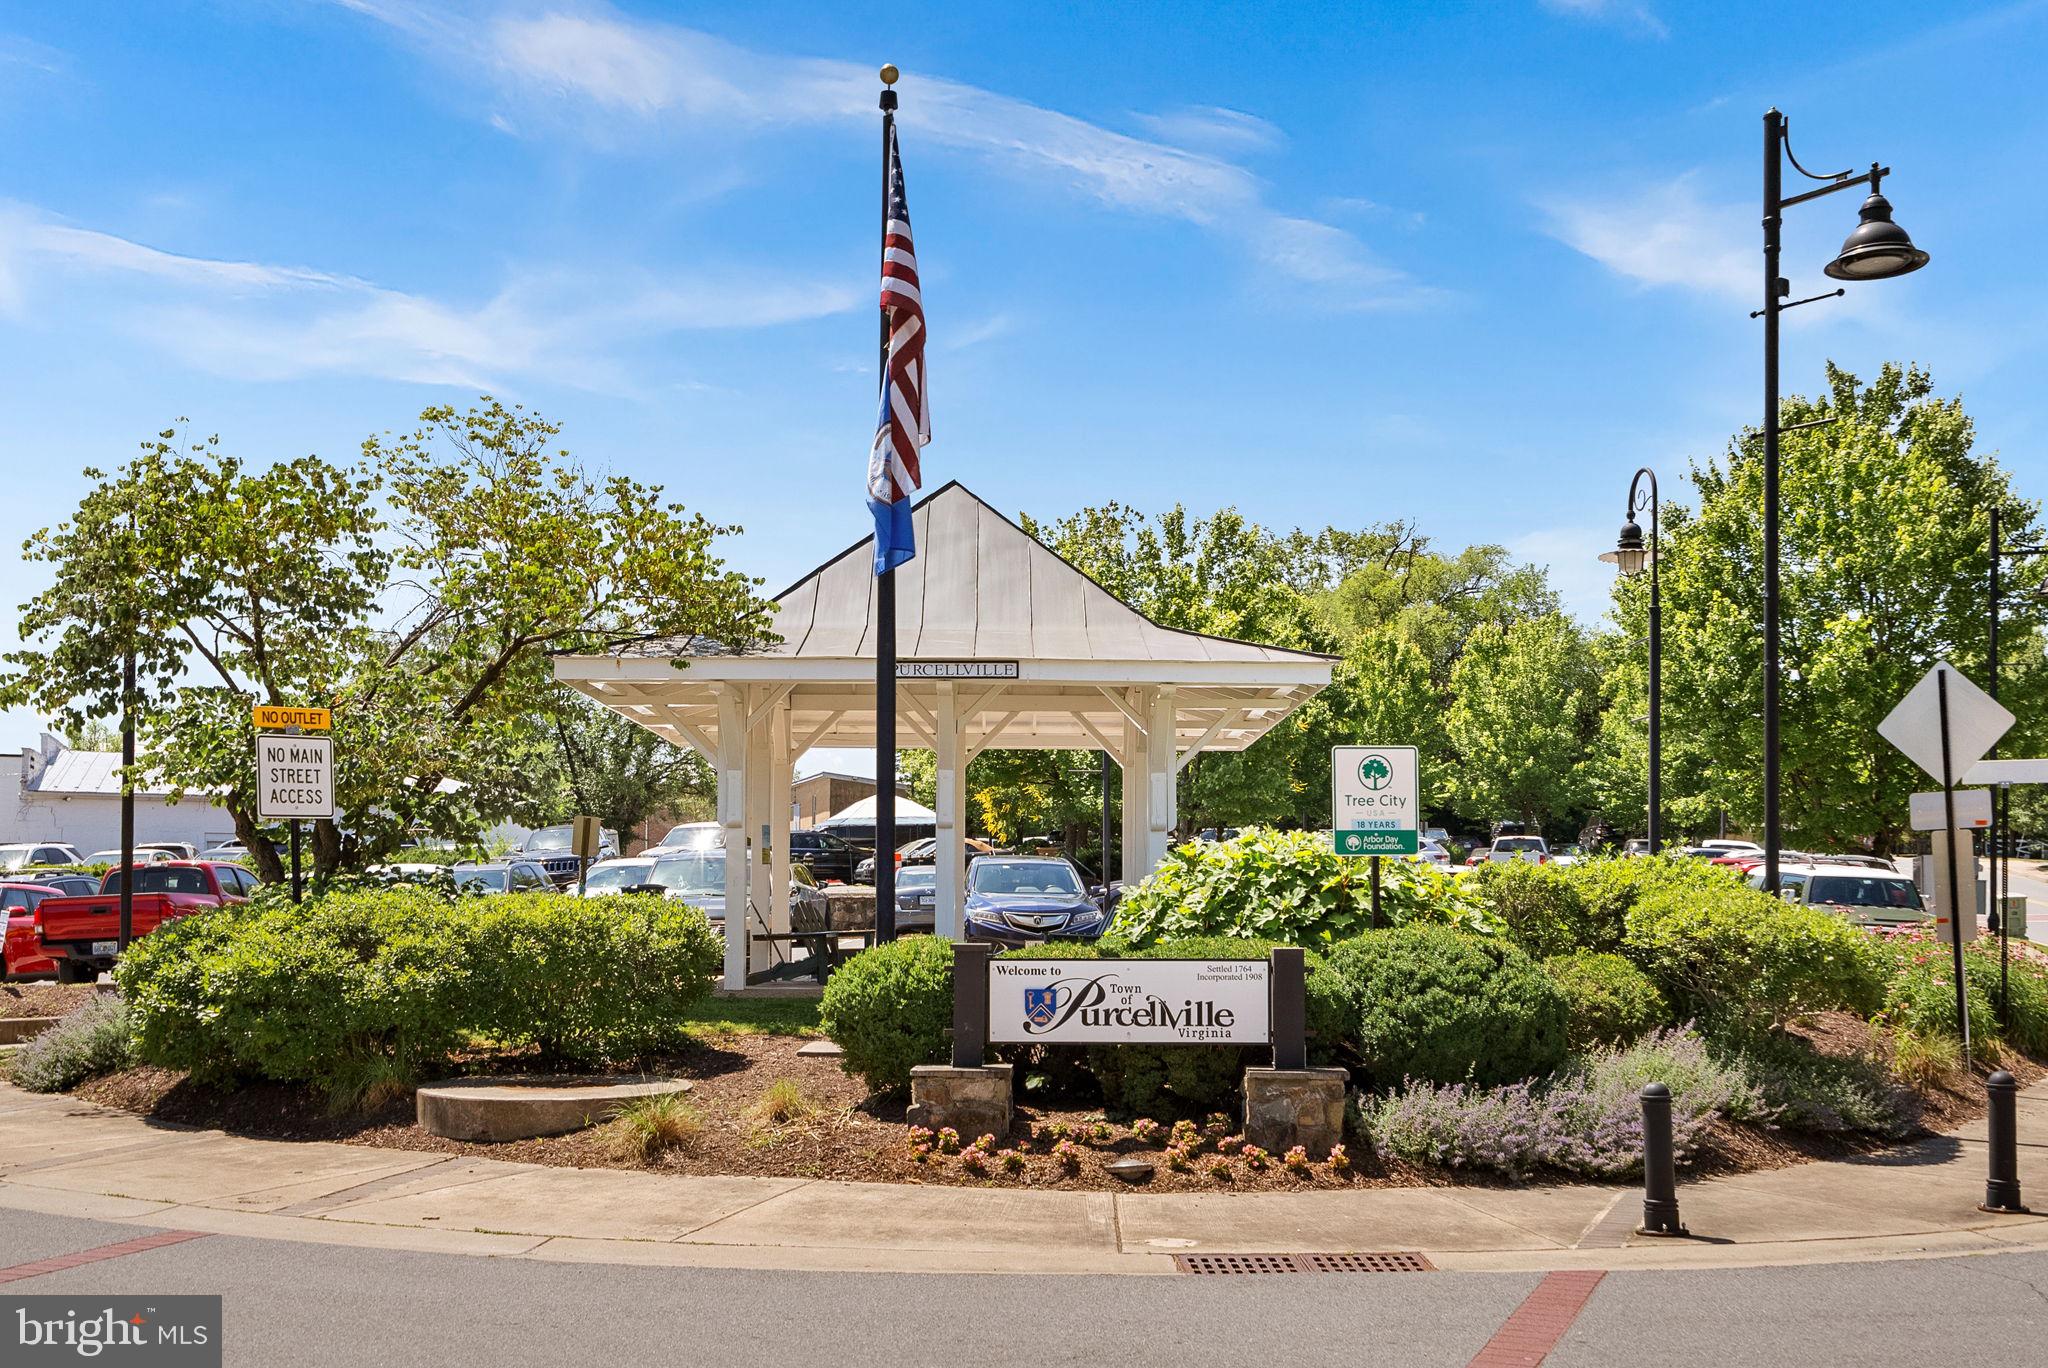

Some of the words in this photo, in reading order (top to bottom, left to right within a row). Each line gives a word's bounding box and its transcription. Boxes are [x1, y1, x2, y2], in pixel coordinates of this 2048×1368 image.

[262, 711, 278, 723] NO
[281, 712, 323, 724] OUTLET
[268, 748, 285, 762] NO
[290, 748, 322, 764] MAIN
[271, 768, 320, 784] STREET
[270, 789, 322, 804] ACCESS
[1345, 794, 1374, 806] Tree
[1380, 794, 1406, 808] City
[1385, 836, 1398, 844] Day
[996, 966, 1048, 976] Welcome
[1050, 966, 1061, 976] to
[1197, 973, 1242, 982] Incorporated
[1110, 984, 1142, 994] Town
[1121, 994, 1133, 1004] of
[1178, 1028, 1232, 1040] Virginia
